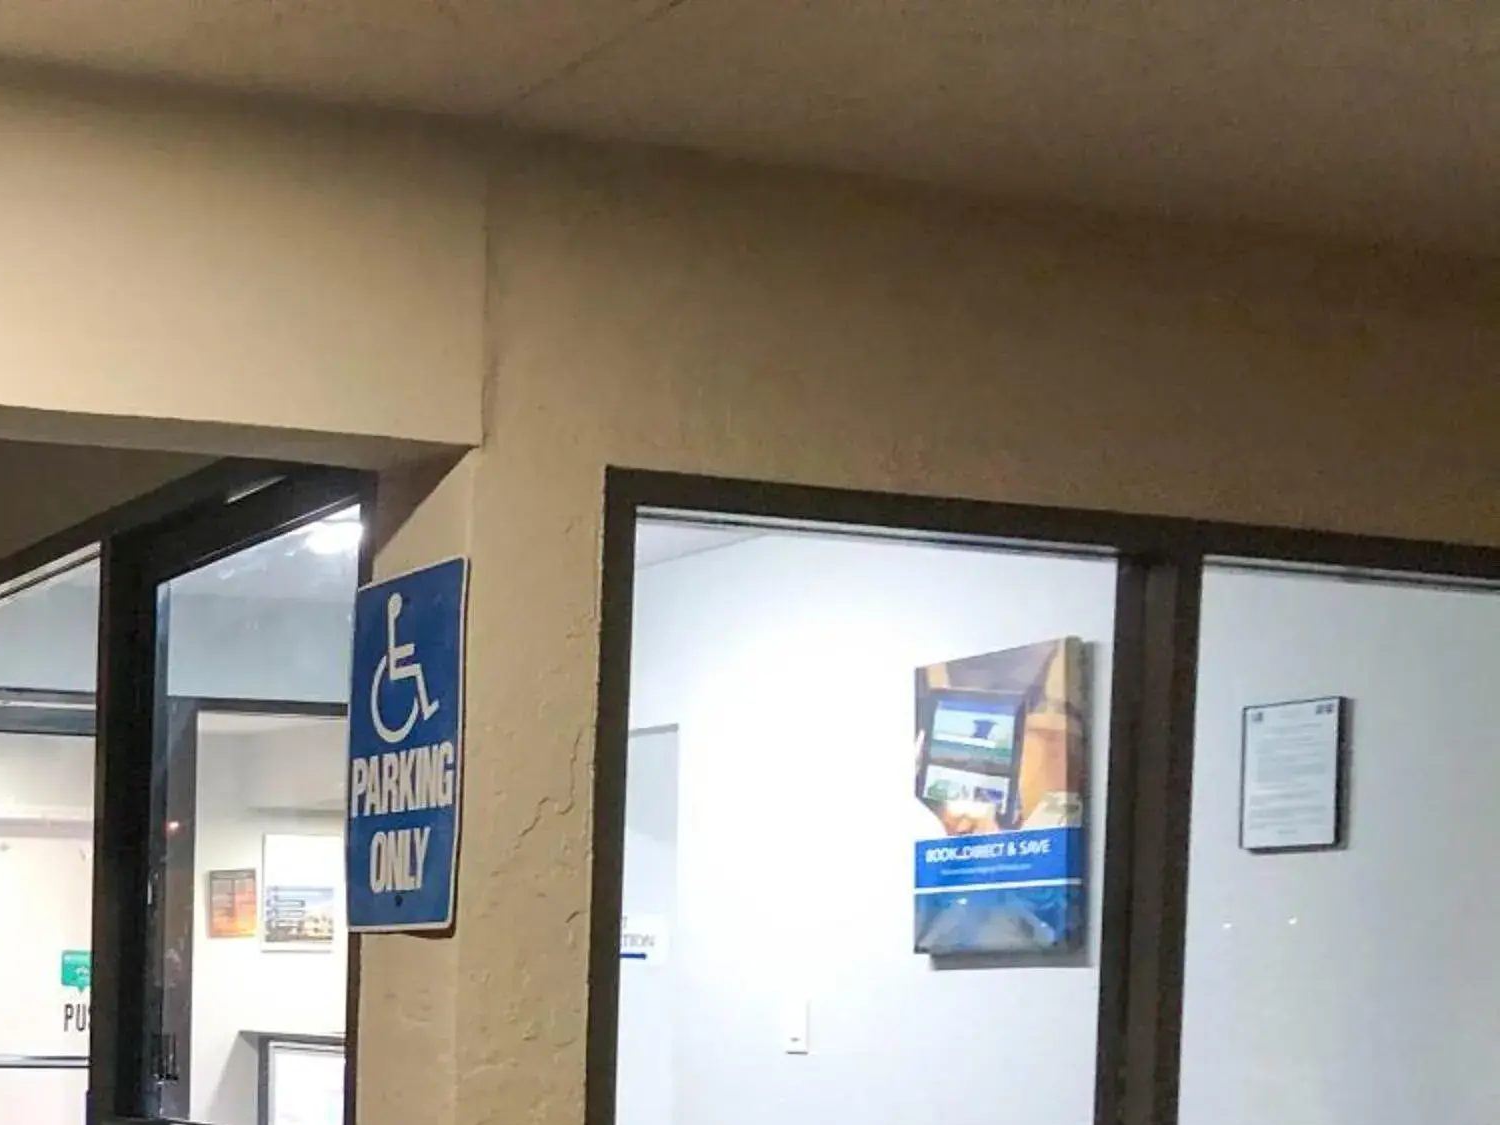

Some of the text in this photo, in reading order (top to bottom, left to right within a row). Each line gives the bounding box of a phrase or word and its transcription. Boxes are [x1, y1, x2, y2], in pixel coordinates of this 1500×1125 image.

[351, 741, 454, 818] PARKING
[370, 827, 431, 893] ONLY
[1007, 841, 1017, 856] &
[1019, 839, 1052, 855] SAVE
[64, 1003, 91, 1032] PU
